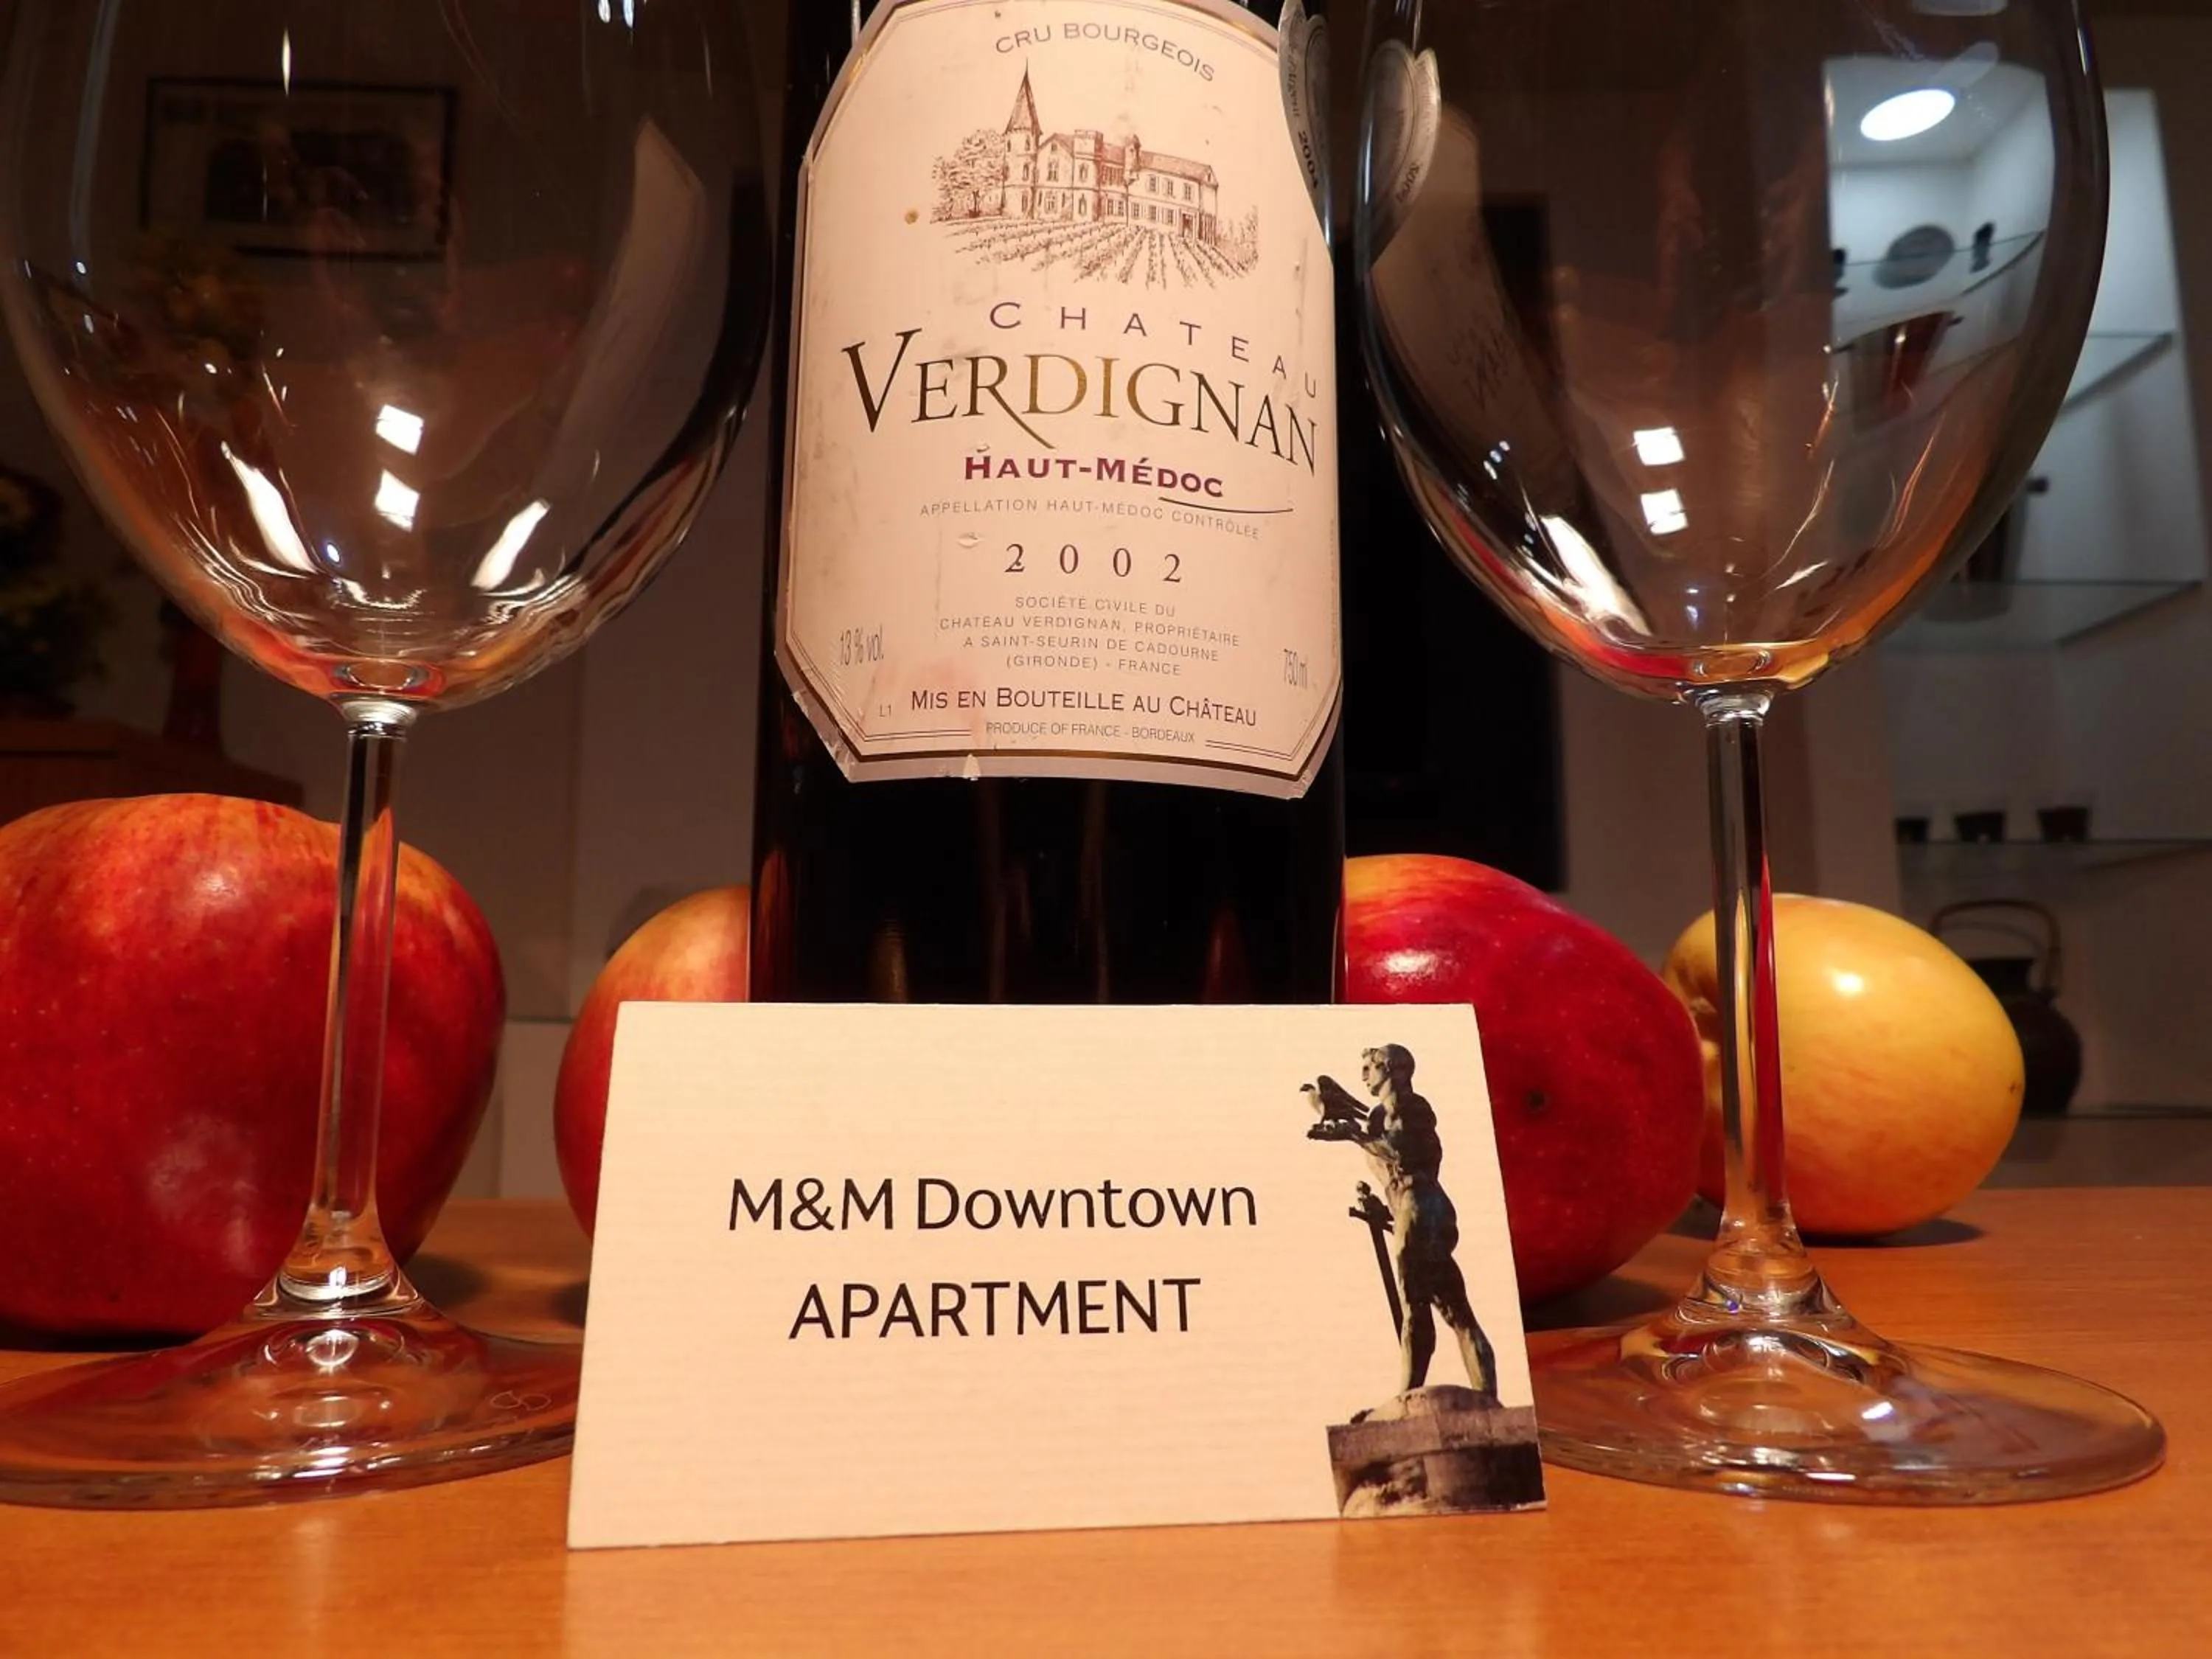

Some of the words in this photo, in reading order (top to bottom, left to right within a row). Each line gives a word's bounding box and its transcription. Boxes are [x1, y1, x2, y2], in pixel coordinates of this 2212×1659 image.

[995, 25, 1051, 55] CRU
[1064, 23, 1215, 82] BOURGEOIS
[990, 302, 1317, 399] CHATEAU
[842, 327, 1317, 476] VERDIGNAN
[964, 455, 1223, 498] HAUT-MÉDOC
[920, 499, 1037, 517] APPELLATION
[1047, 500, 1163, 520] HAUT-MÉDOC
[1172, 510, 1259, 539] CONTRÔLÉE
[1005, 543, 1181, 582] 2002
[1015, 595, 1087, 610] SOCIÉTÉ
[1095, 599, 1147, 614] CIVILE
[1155, 604, 1175, 617] DU
[839, 629, 852, 666] 13
[939, 616, 1015, 630] CHATEAU
[1023, 616, 1125, 633] VERDIGNAN,
[1135, 621, 1239, 647] PROPRIÉTAIRE
[963, 637, 973, 647] A
[981, 635, 1099, 649] SAINT-SEURIN
[1107, 638, 1127, 651] DE
[1134, 641, 1219, 661] CADOURNE
[1006, 655, 1099, 671] (GIRONDE)
[1118, 658, 1180, 675] FRANCE
[911, 689, 948, 710] MIS
[958, 691, 986, 709] EN
[996, 687, 1124, 711] BOUTEILLE
[1133, 695, 1161, 713] AU
[1169, 695, 1256, 726] CHÂTEAU
[986, 722, 1046, 735] PRODUCE
[1051, 723, 1069, 734] OF
[1071, 723, 1121, 737] FRANCE
[1131, 726, 1195, 743] BORDEAUX
[728, 1177, 894, 1231] M&M
[917, 1178, 1257, 1230] Downtown
[789, 1277, 1201, 1340] APARTMENT
